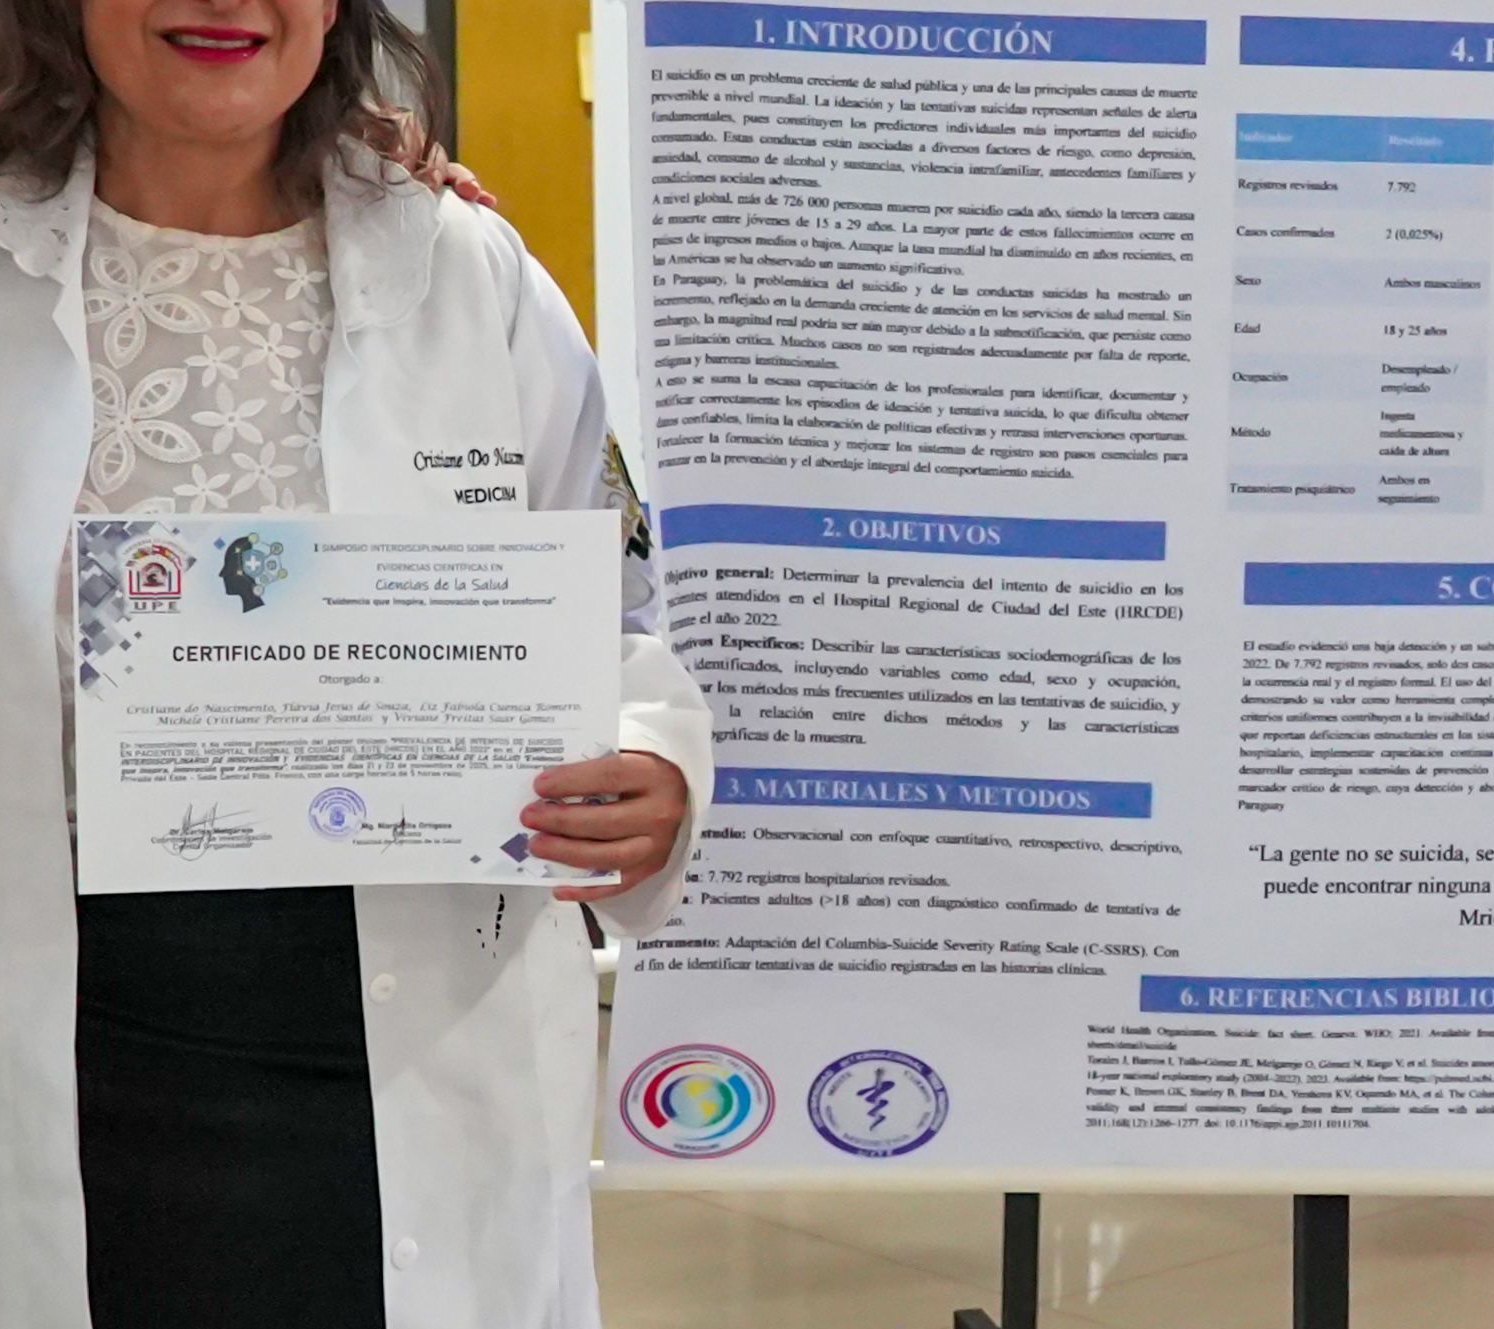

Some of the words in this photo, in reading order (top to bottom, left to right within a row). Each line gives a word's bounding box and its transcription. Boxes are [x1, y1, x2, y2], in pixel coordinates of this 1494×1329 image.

[754, 18, 775, 44] 1.
[785, 20, 1053, 55] INTRODUCCIÓN
[1450, 36, 1475, 63] 4.
[454, 486, 517, 505] MEDICINA
[822, 517, 842, 538] 2.
[848, 518, 1001, 545] OBJETIVOS
[375, 578, 430, 592] Ciencias
[433, 577, 450, 591] de
[454, 577, 467, 592] la
[471, 577, 509, 592] Salud
[1438, 575, 1461, 600] 5.
[132, 600, 180, 613] UPE
[172, 644, 306, 662] CERTIFICADO
[313, 643, 341, 661] DE
[347, 643, 527, 661] RECONOCIMIENTO
[318, 673, 371, 687] Otorgado
[727, 777, 747, 797] 3.
[755, 778, 929, 802] MATERIALES
[935, 783, 947, 803] Y
[959, 785, 1091, 810] METODOS
[1289, 847, 1340, 867] gente
[1346, 849, 1369, 862] no
[1374, 849, 1394, 862] se
[1399, 843, 1470, 864] suicida,
[1475, 848, 1494, 862] se
[1263, 876, 1320, 900] puede
[1324, 879, 1413, 895] encontrar
[1417, 881, 1492, 899] ninguna
[1179, 987, 1200, 1007] 6.
[1208, 987, 1399, 1009] REFERENCIAS
